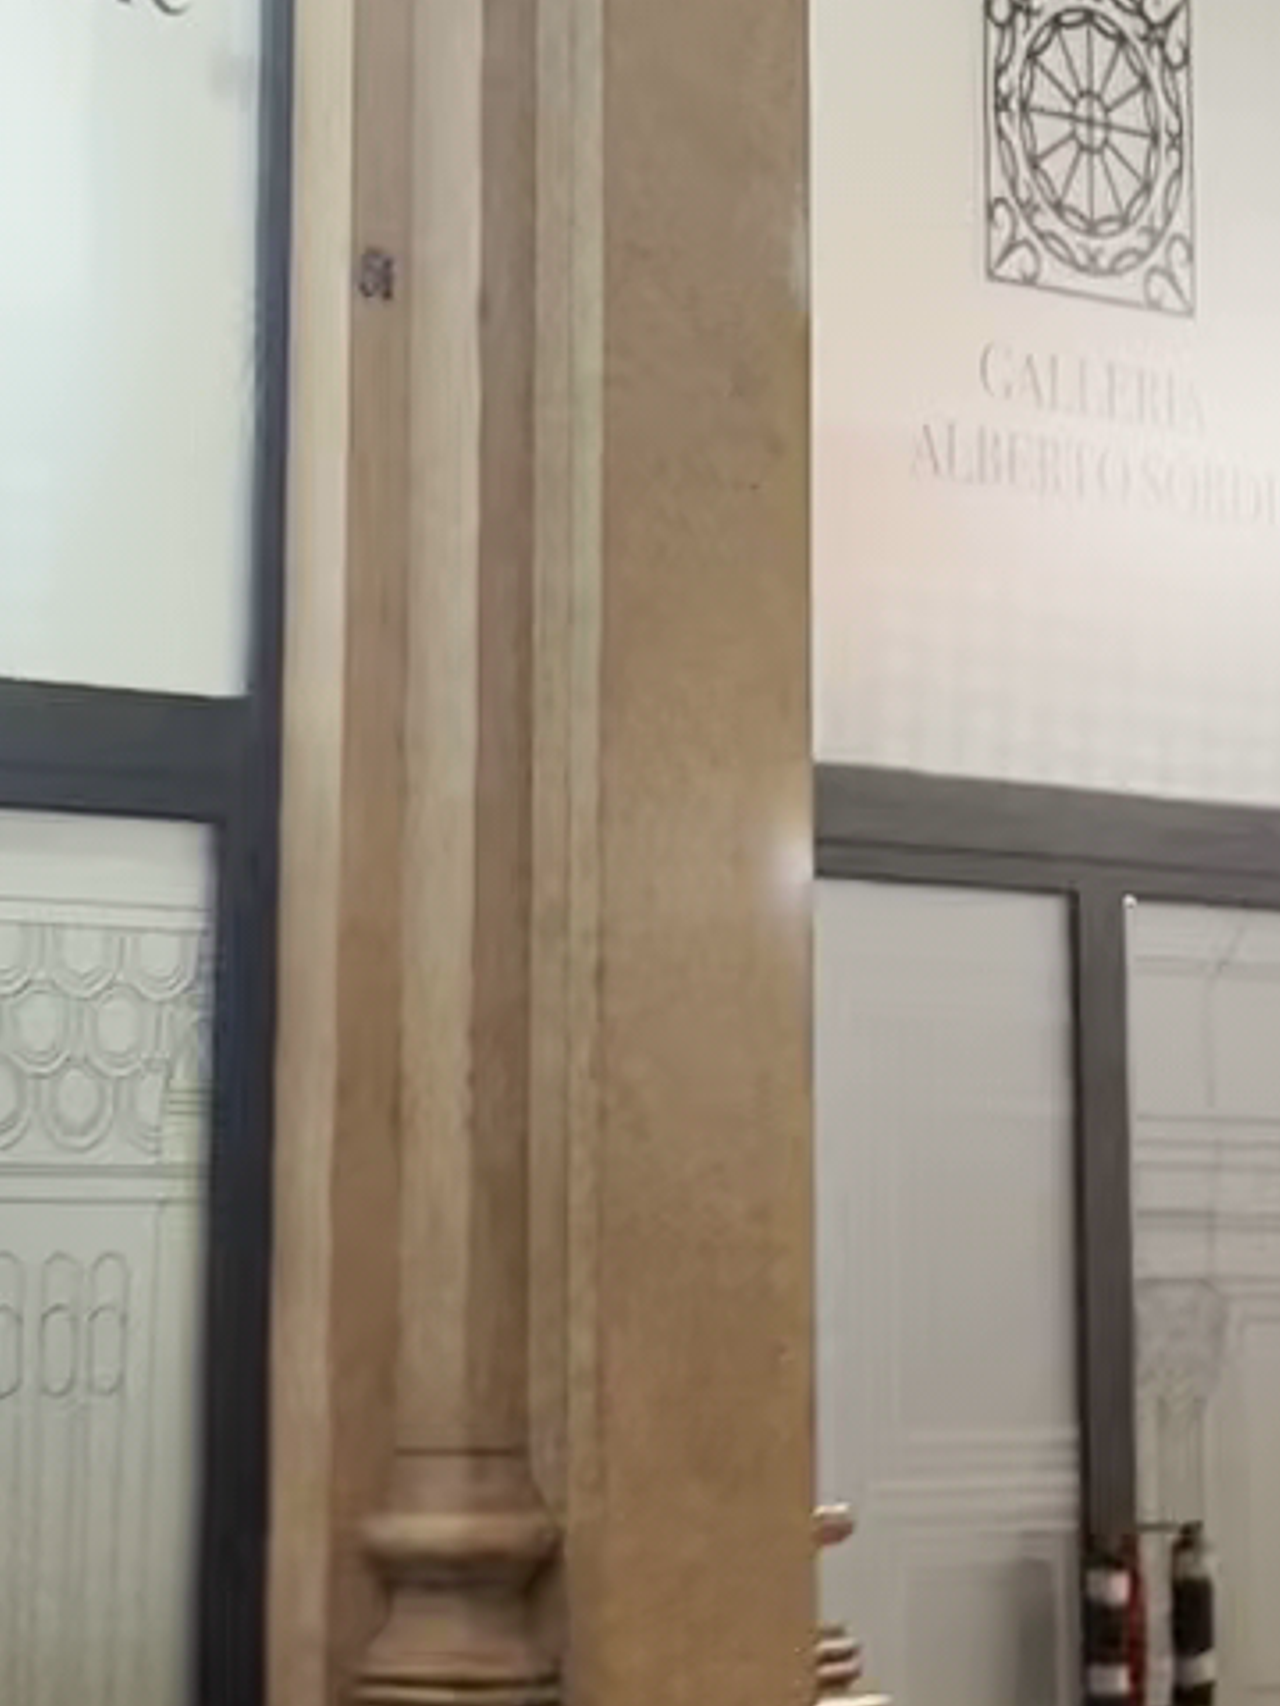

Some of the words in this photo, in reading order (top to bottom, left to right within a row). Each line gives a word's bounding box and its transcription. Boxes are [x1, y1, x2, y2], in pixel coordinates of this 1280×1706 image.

[978, 339, 1206, 438] GALLERIA
[910, 420, 1132, 506] ALBERTO
[1141, 454, 1280, 526] SORDI
